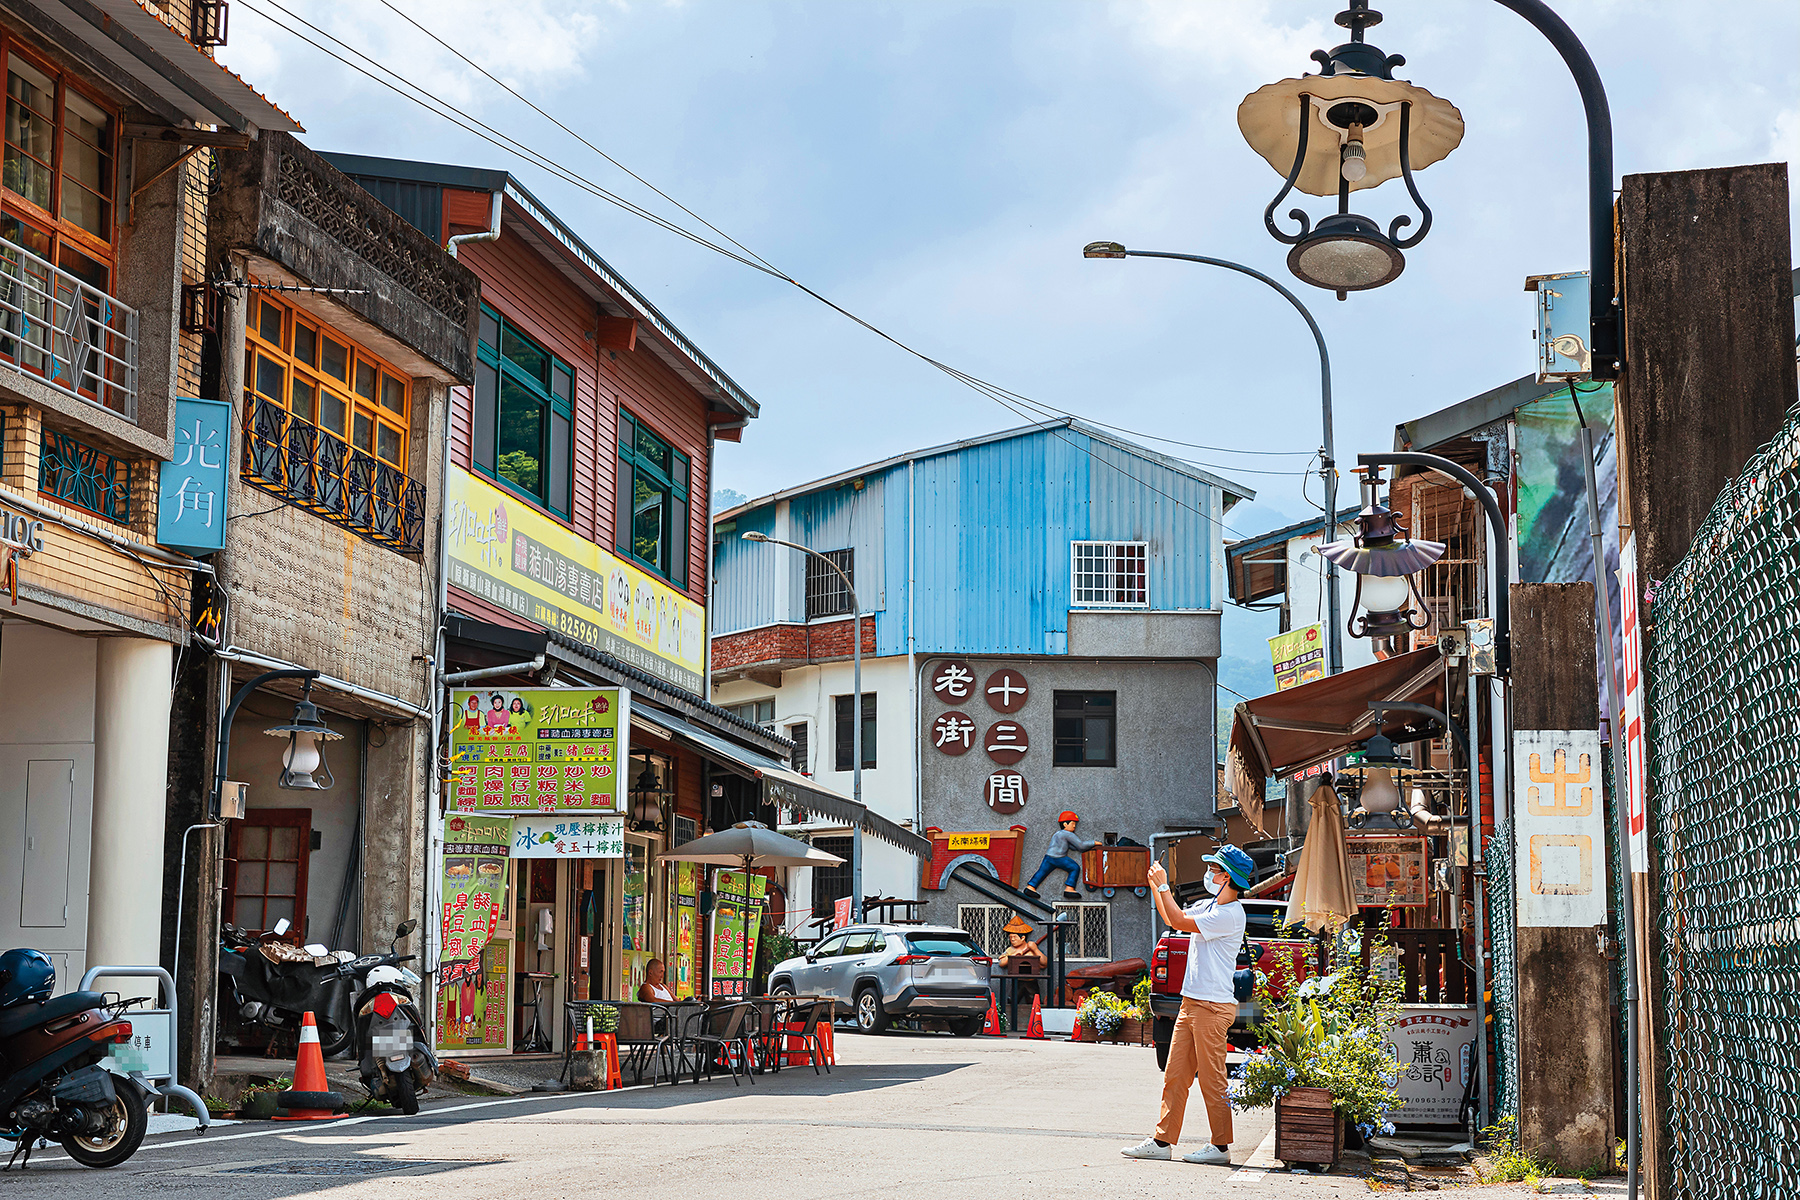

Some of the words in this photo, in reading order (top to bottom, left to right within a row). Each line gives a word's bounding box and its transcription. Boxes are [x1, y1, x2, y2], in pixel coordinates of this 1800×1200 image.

[166, 418, 221, 528] 光角
[529, 545, 603, 610] 豬血湯專賣店
[560, 613, 599, 647] 825969
[934, 664, 975, 748] 老街
[488, 744, 528, 757] 臭豆腐
[987, 675, 1028, 806] 十三間
[457, 766, 478, 806] 蚵仔麵線
[483, 766, 504, 806] 肉燥飯
[510, 766, 531, 806] 蚵仔煎
[536, 765, 558, 806] 炒粄條
[563, 765, 585, 806] 炒米粉
[516, 827, 539, 850] 冰
[555, 822, 624, 837] 現壓檸檬汁
[1528, 749, 1592, 895] 出口
